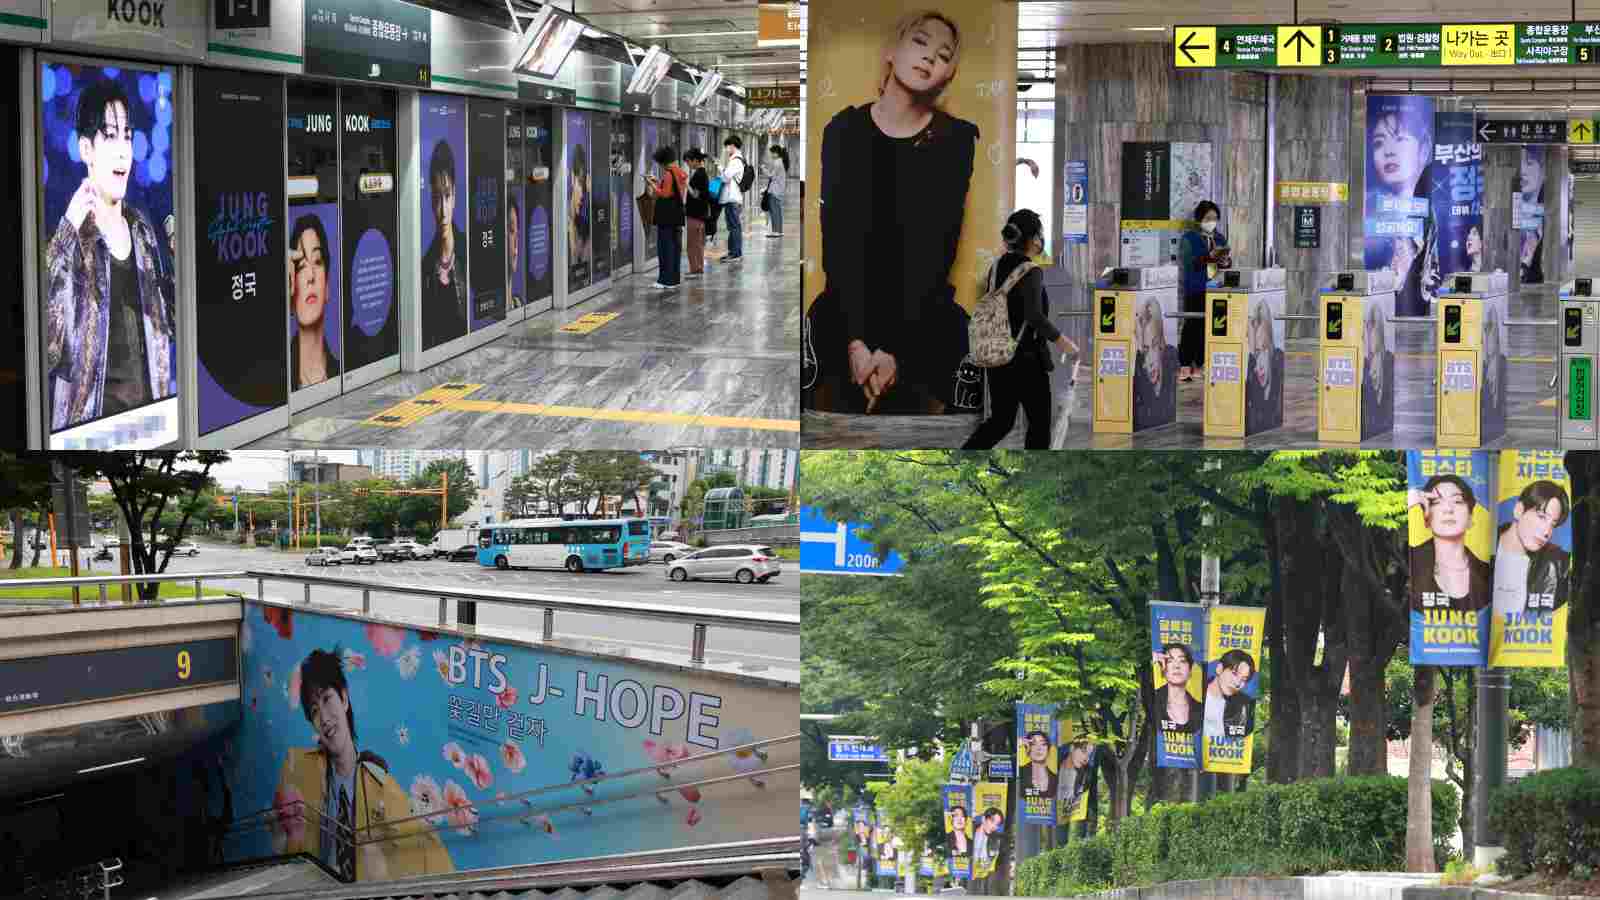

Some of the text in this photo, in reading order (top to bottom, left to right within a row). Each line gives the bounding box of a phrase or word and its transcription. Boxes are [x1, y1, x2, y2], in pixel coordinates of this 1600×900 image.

[1327, 30, 1335, 42] 1
[1384, 38, 1393, 52] 2
[1446, 30, 1509, 49] 나가는 곳
[1223, 40, 1231, 52] 4
[1526, 45, 1568, 57] 사직야구장
[1580, 48, 1589, 62] 5
[1327, 50, 1335, 63] 3
[305, 114, 333, 132] JUNG
[345, 113, 370, 132] KOOK
[231, 271, 257, 301] 정국
[848, 553, 880, 568] 200m
[1423, 609, 1478, 625] JUNG
[1423, 627, 1480, 645] KOOK
[1504, 627, 1553, 645] KOOK
[177, 650, 191, 680] 9
[447, 644, 722, 750] BTS J- HOPE
[448, 695, 501, 734] 꽃길만
